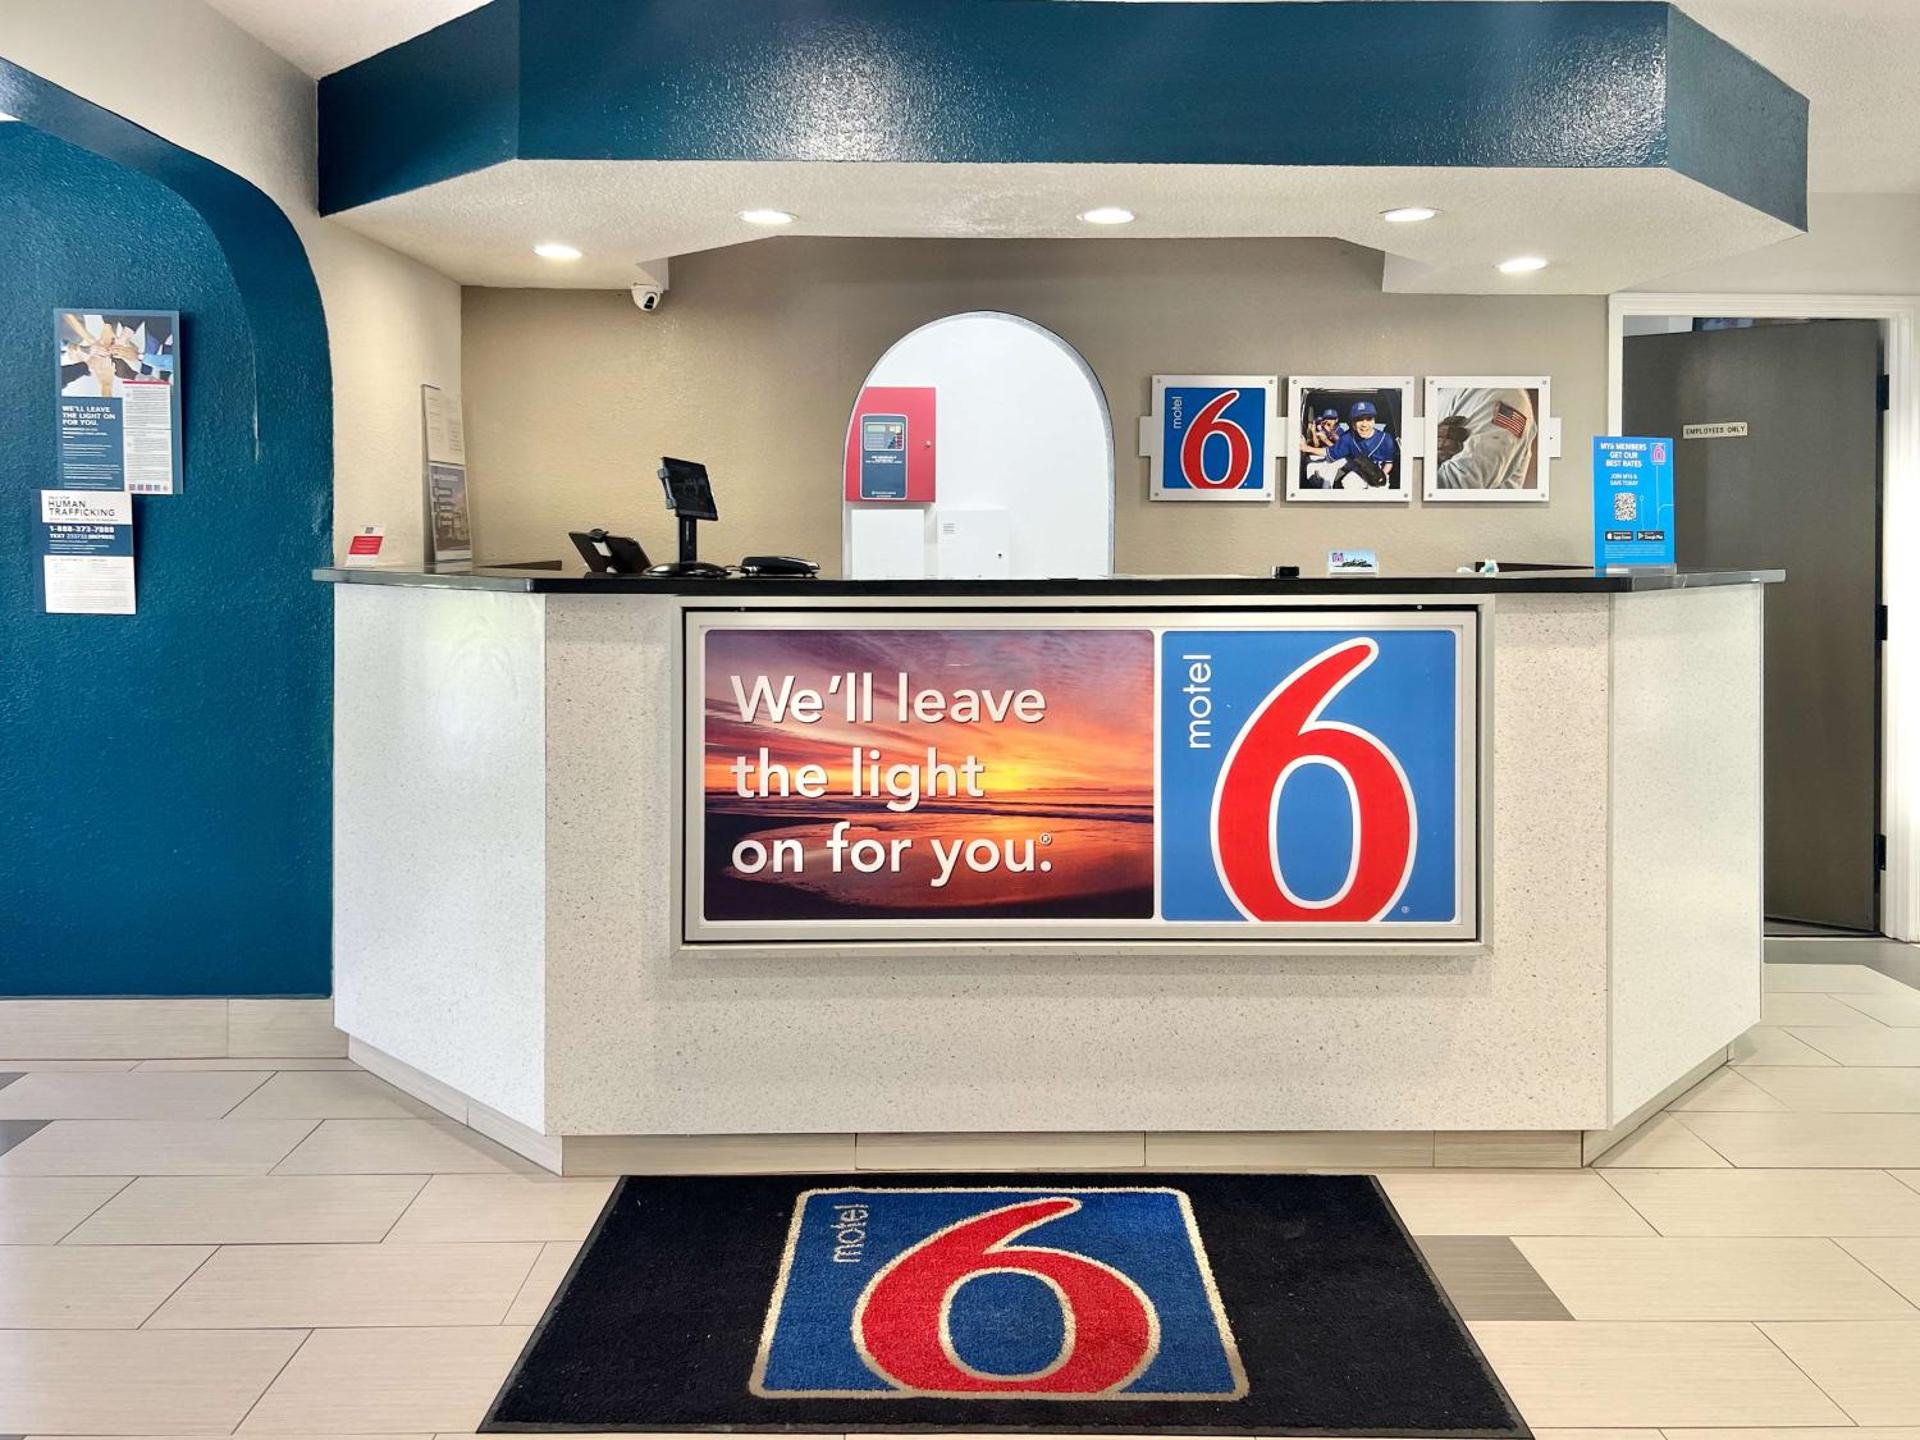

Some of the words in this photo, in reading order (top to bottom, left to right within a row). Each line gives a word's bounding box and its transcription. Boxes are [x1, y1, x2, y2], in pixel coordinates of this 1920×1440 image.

[1171, 396, 1183, 429] motel
[1180, 389, 1253, 489] 6
[1685, 426, 1724, 435] EMPLOYEES
[1727, 425, 1745, 433] ONLY
[1615, 442, 1647, 451] MEMBERS
[1623, 451, 1638, 459] OUR
[1605, 459, 1622, 467] BEST
[1622, 460, 1642, 468] RATES
[48, 500, 86, 508] HUMAN
[49, 507, 115, 517] TRAFFICKING
[730, 671, 874, 725] We'll
[898, 671, 1047, 725] leave
[730, 747, 828, 799] the
[852, 747, 986, 813] light
[1182, 653, 1213, 750] motel
[1209, 636, 1419, 923] 6
[730, 838, 805, 874] on
[826, 821, 912, 874] for
[832, 1203, 869, 1264] motel
[851, 1196, 1161, 1396] 6
